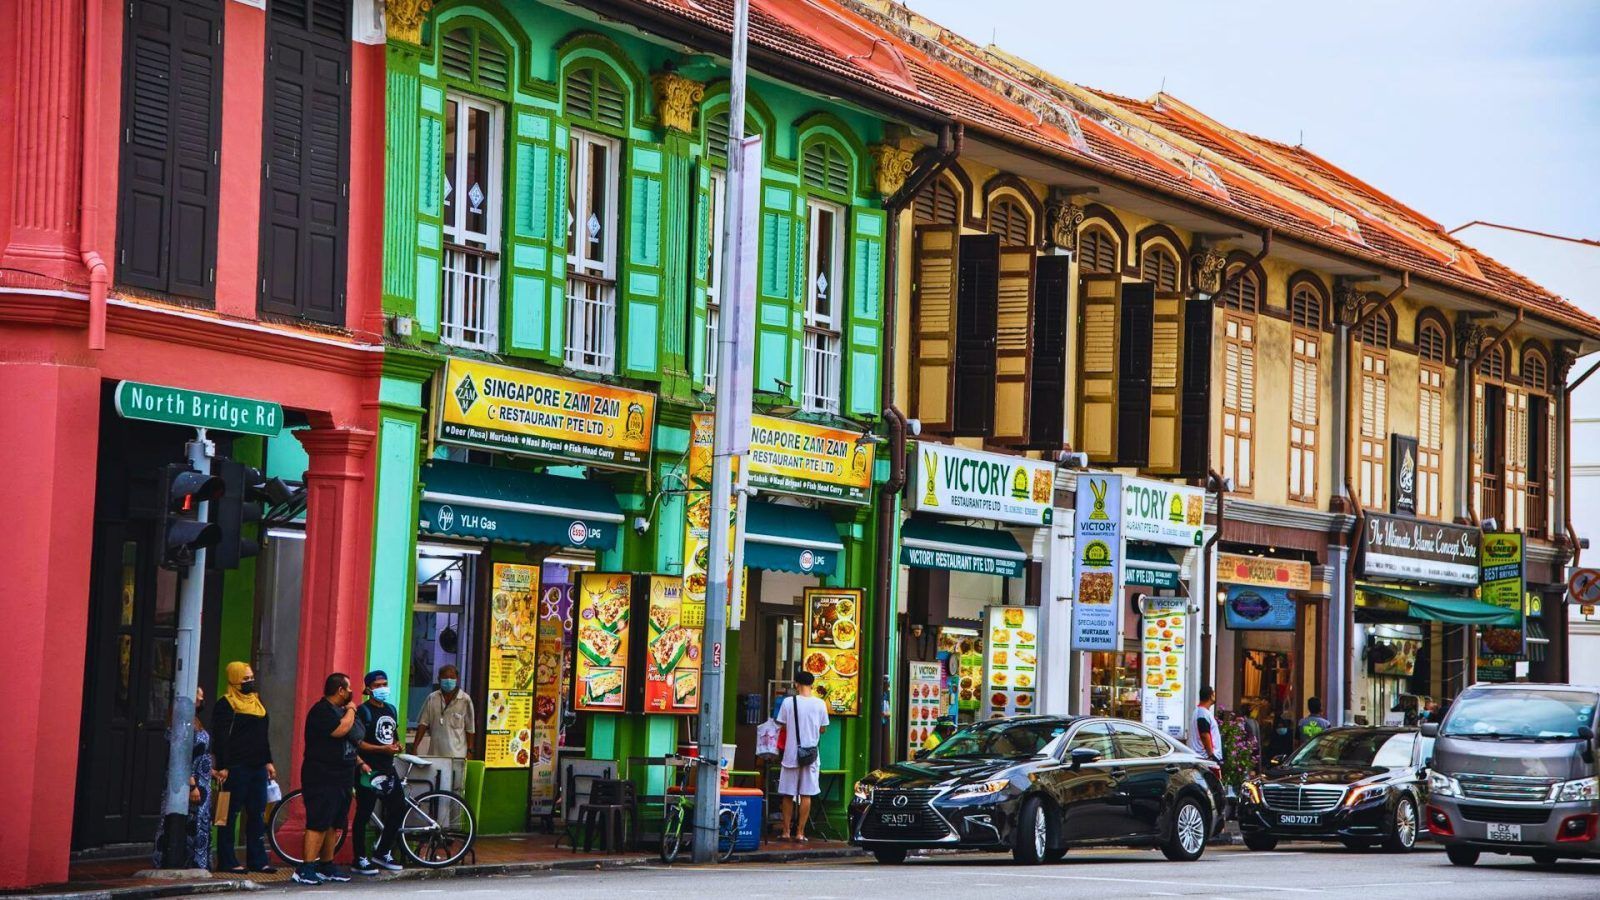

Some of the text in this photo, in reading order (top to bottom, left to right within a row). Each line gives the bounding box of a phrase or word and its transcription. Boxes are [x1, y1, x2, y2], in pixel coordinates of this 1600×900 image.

[464, 379, 470, 388] Z
[458, 387, 476, 400] ZAM
[483, 378, 620, 417] SINGAPORE ZAM ZAM
[131, 387, 275, 427] North Bridge Rd
[500, 406, 604, 435] RESTAURANT PTE LTD
[450, 426, 466, 436] Deer
[467, 428, 488, 441] (Rusa)
[489, 431, 519, 443] Murtabak
[526, 437, 540, 447] Nasi
[541, 439, 562, 451] Briyani
[568, 444, 581, 453] Fish
[582, 446, 597, 456] Head
[598, 448, 615, 459] Curry
[751, 428, 848, 458] NGAPORE ZAM ZAM
[752, 450, 834, 473] RESTAURANT PTE LTD
[945, 455, 1011, 497] VICTORY
[749, 474, 768, 483] urtabak
[807, 482, 817, 490] Fish
[817, 482, 830, 492] Head
[830, 485, 843, 495] Curry
[951, 496, 982, 509] RESTAURANT
[983, 499, 992, 510] PTE
[992, 500, 1001, 511] LTD
[461, 515, 497, 530] YLH Gas
[1081, 522, 1117, 531] VICTORY
[1126, 521, 1144, 530] AURANT
[572, 526, 585, 537] Esso
[588, 528, 601, 539] LPG
[1369, 519, 1476, 560] The Ultimate Islamic Concept Store
[814, 556, 825, 565] LPG
[909, 549, 995, 572] VICTORY RESTAURANT PTE LTD
[1135, 570, 1145, 583] PTE
[1145, 571, 1155, 584] LTD
[1484, 567, 1498, 581] BEST
[664, 587, 678, 596] ZAM
[1078, 619, 1107, 627] SPECIALISED
[919, 666, 938, 675] VICTORY
[881, 814, 915, 823] SFA97U
[1498, 823, 1510, 831] GX
